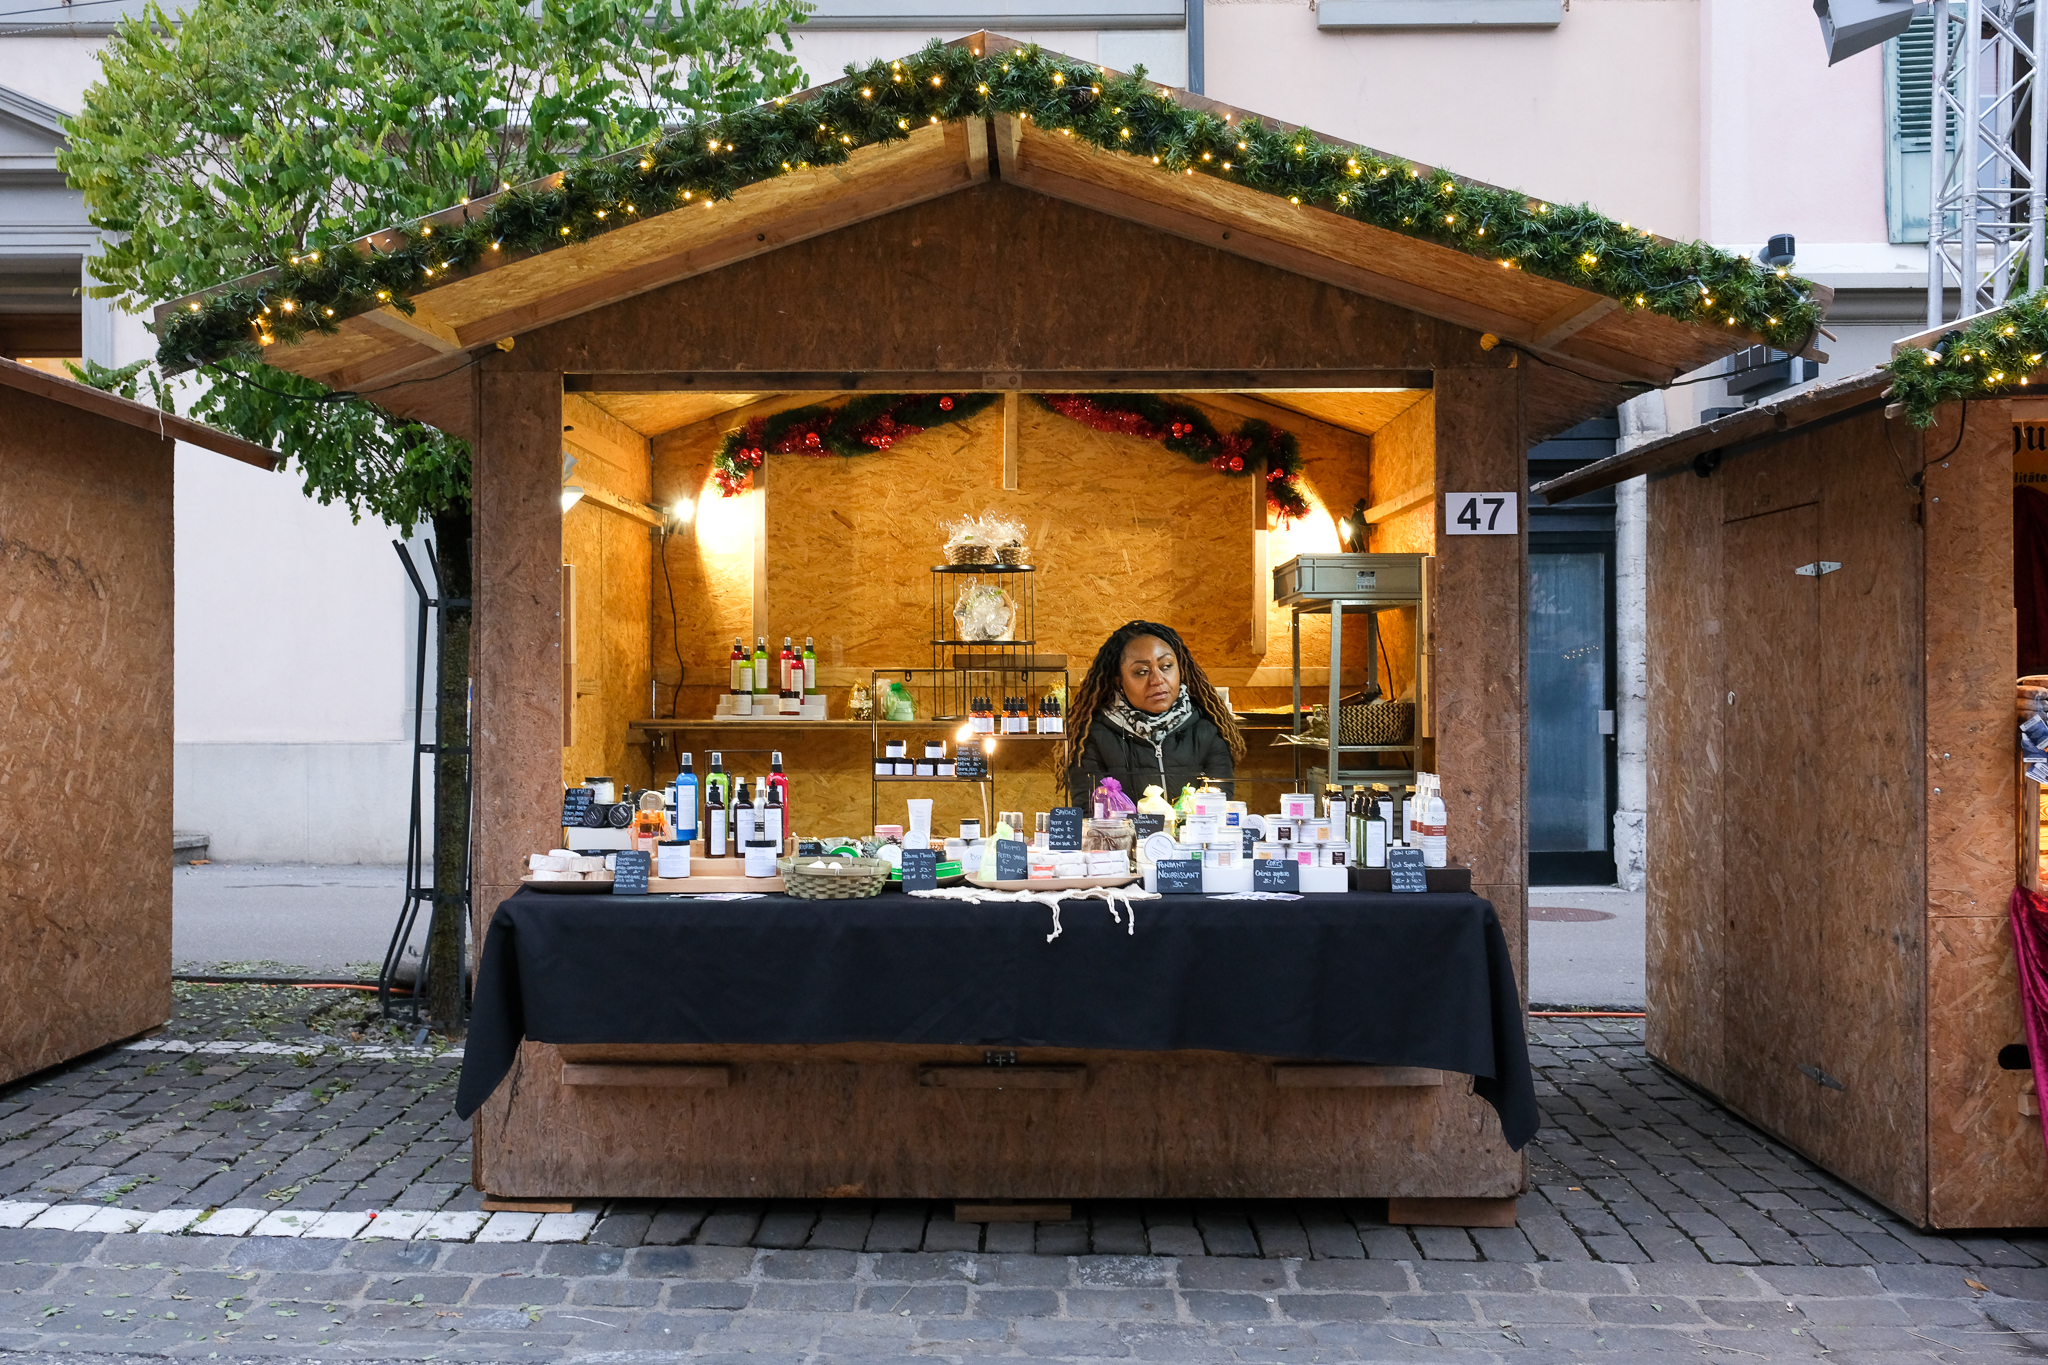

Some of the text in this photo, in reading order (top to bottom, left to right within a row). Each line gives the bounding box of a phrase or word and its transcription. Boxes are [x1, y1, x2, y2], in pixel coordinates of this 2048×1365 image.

[1457, 497, 1505, 531] 47
[1055, 808, 1077, 816] SAVONS
[1157, 869, 1200, 879] NOURRISSANT
